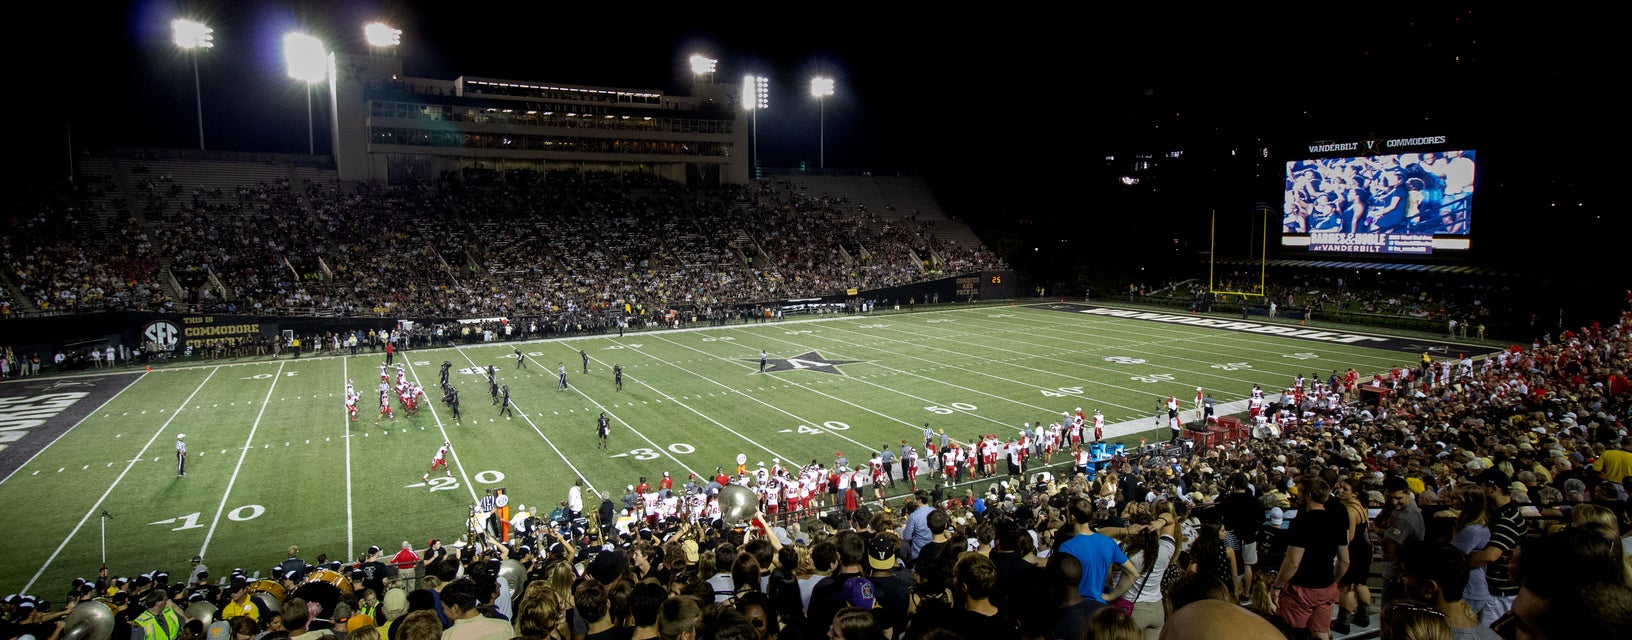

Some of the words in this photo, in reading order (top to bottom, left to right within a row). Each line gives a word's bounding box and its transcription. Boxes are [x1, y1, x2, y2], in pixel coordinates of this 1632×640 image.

[526, 102, 609, 114] VANDERBILT
[1309, 142, 1359, 153] VANDERBILT
[1366, 140, 1375, 149] V
[1387, 135, 1446, 148] COMMODORES
[991, 276, 1001, 284] 25
[184, 324, 260, 337] COMMODORE
[1078, 307, 1389, 342] VANDERBILT
[144, 322, 179, 347] SEC
[1131, 373, 1176, 383] 30
[1040, 386, 1085, 398] 40
[924, 402, 978, 415] 50
[797, 420, 850, 435] 40
[630, 442, 696, 461] 30
[428, 470, 505, 493] 20
[171, 505, 266, 532] 10
[879, 551, 886, 560] V
[210, 627, 224, 638] T
